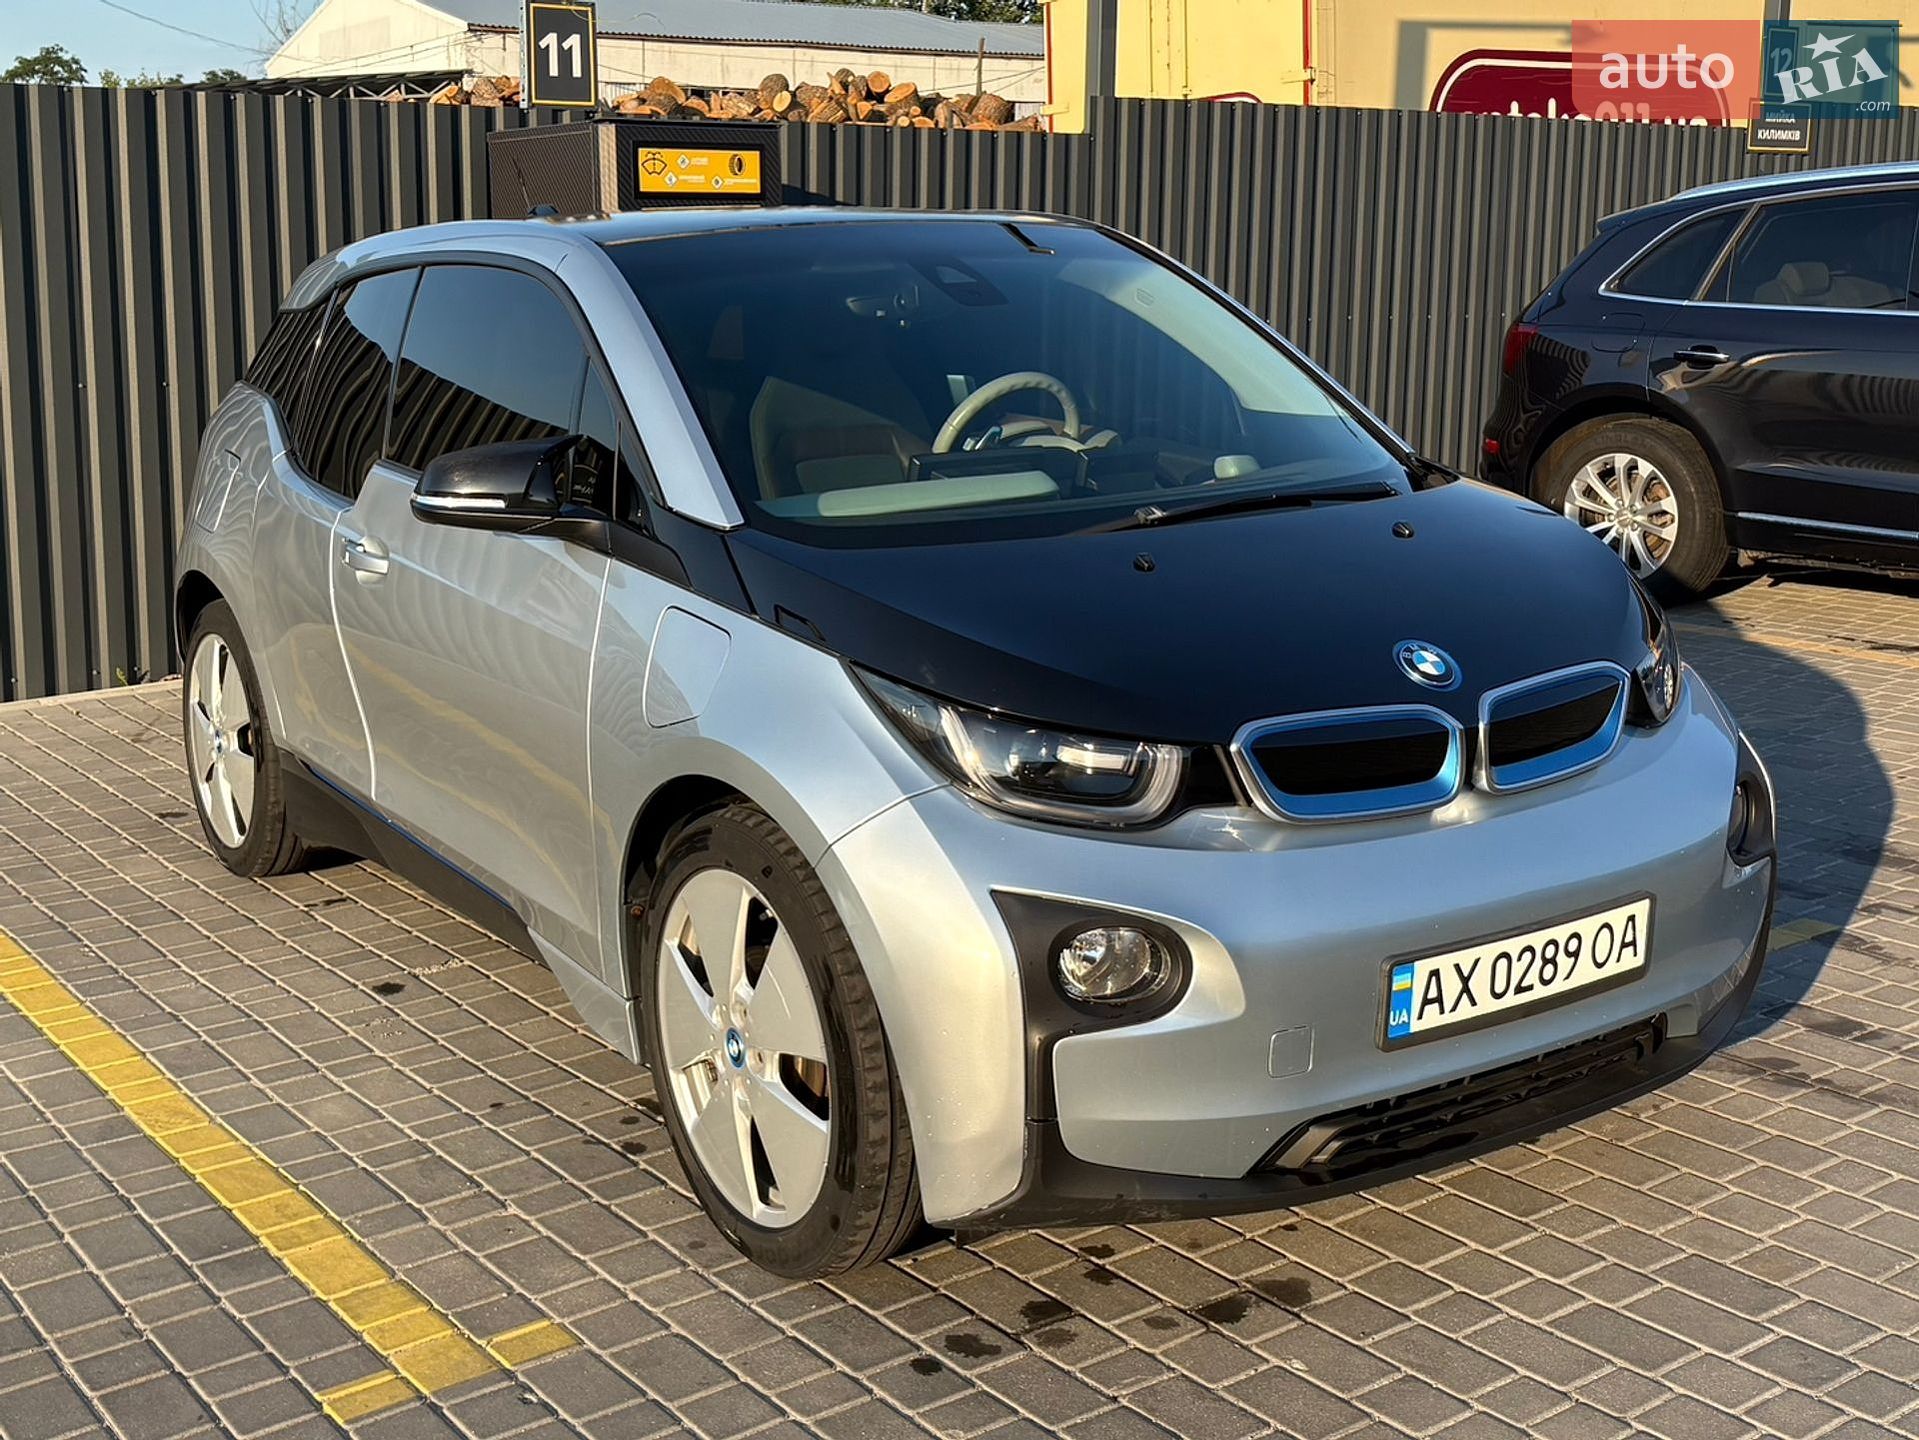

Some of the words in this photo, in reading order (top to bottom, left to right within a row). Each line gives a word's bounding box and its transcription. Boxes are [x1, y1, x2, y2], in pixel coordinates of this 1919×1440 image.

[538, 32, 583, 78] 11
[1770, 47, 1793, 77] 12
[1416, 957, 1481, 1021] AX
[1489, 932, 1582, 1000] 0289
[1591, 914, 1638, 969] OA
[1389, 1010, 1409, 1026] UA
